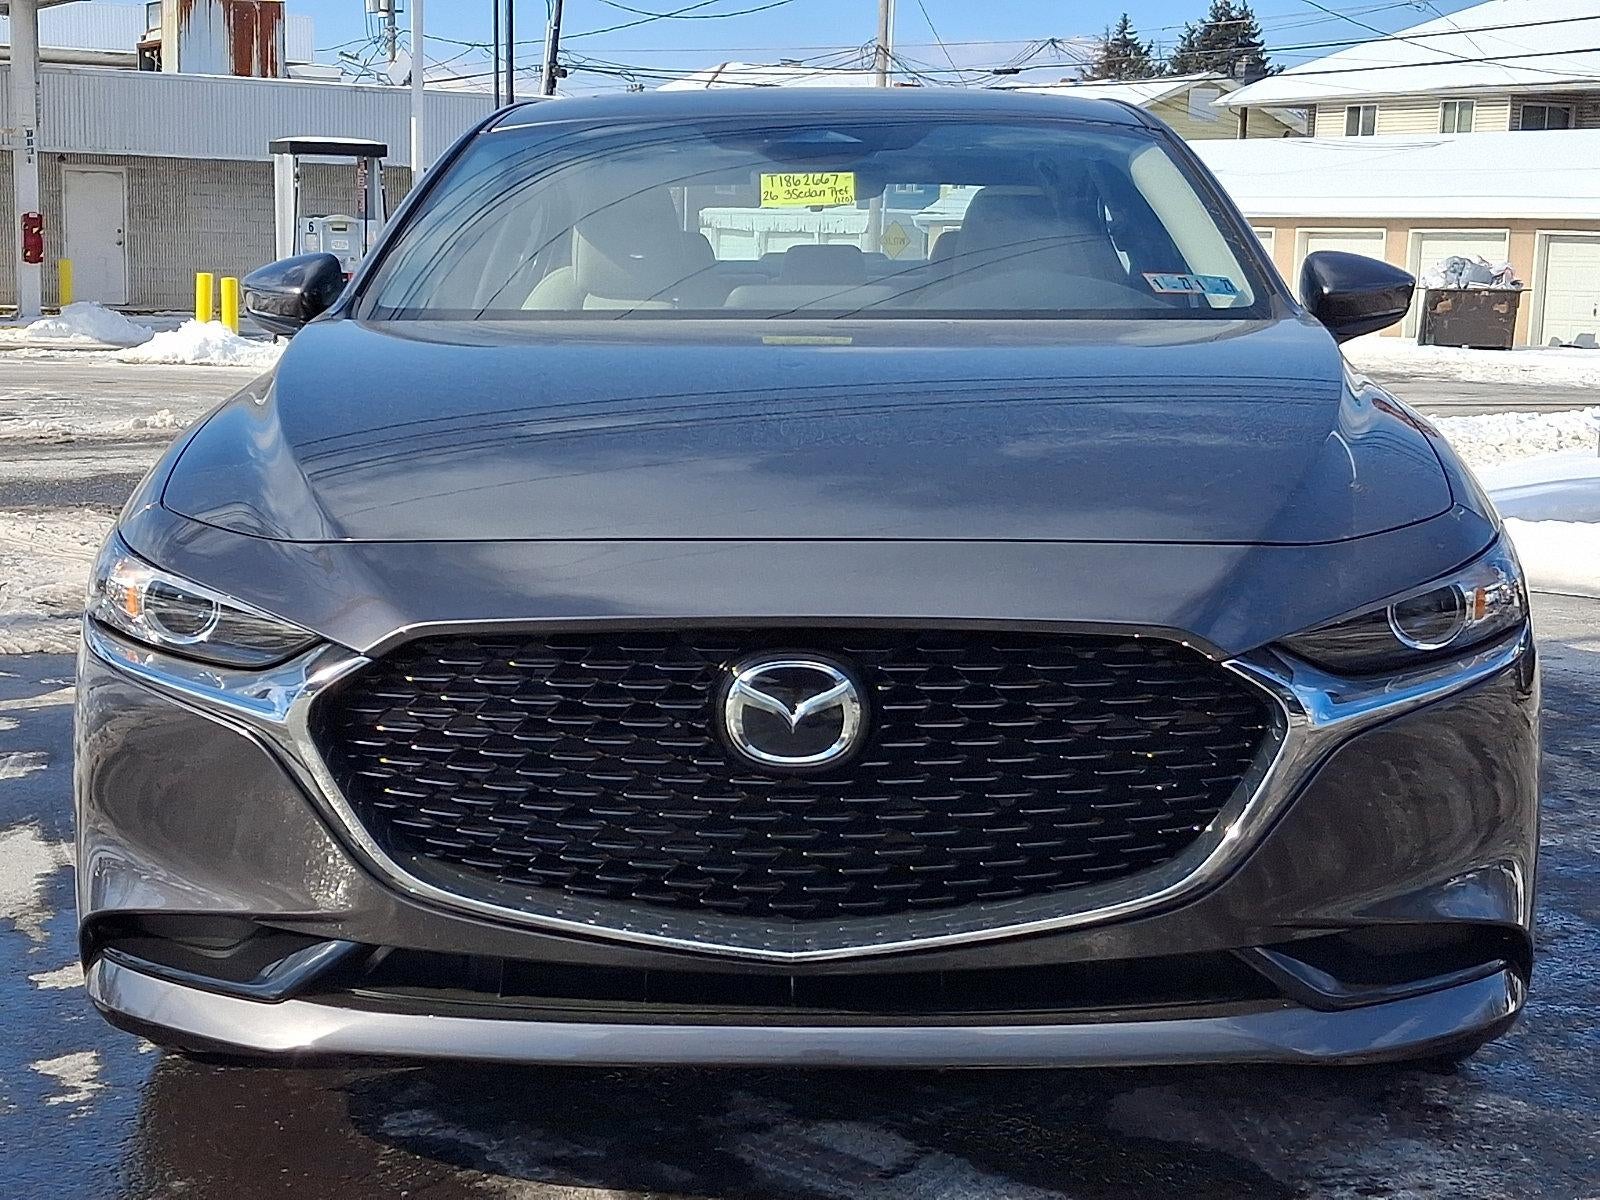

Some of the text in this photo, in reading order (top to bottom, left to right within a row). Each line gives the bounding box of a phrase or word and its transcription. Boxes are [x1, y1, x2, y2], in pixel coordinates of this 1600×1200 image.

[767, 173, 839, 187] T1862667
[763, 190, 778, 201] 26
[308, 221, 315, 233] 6
